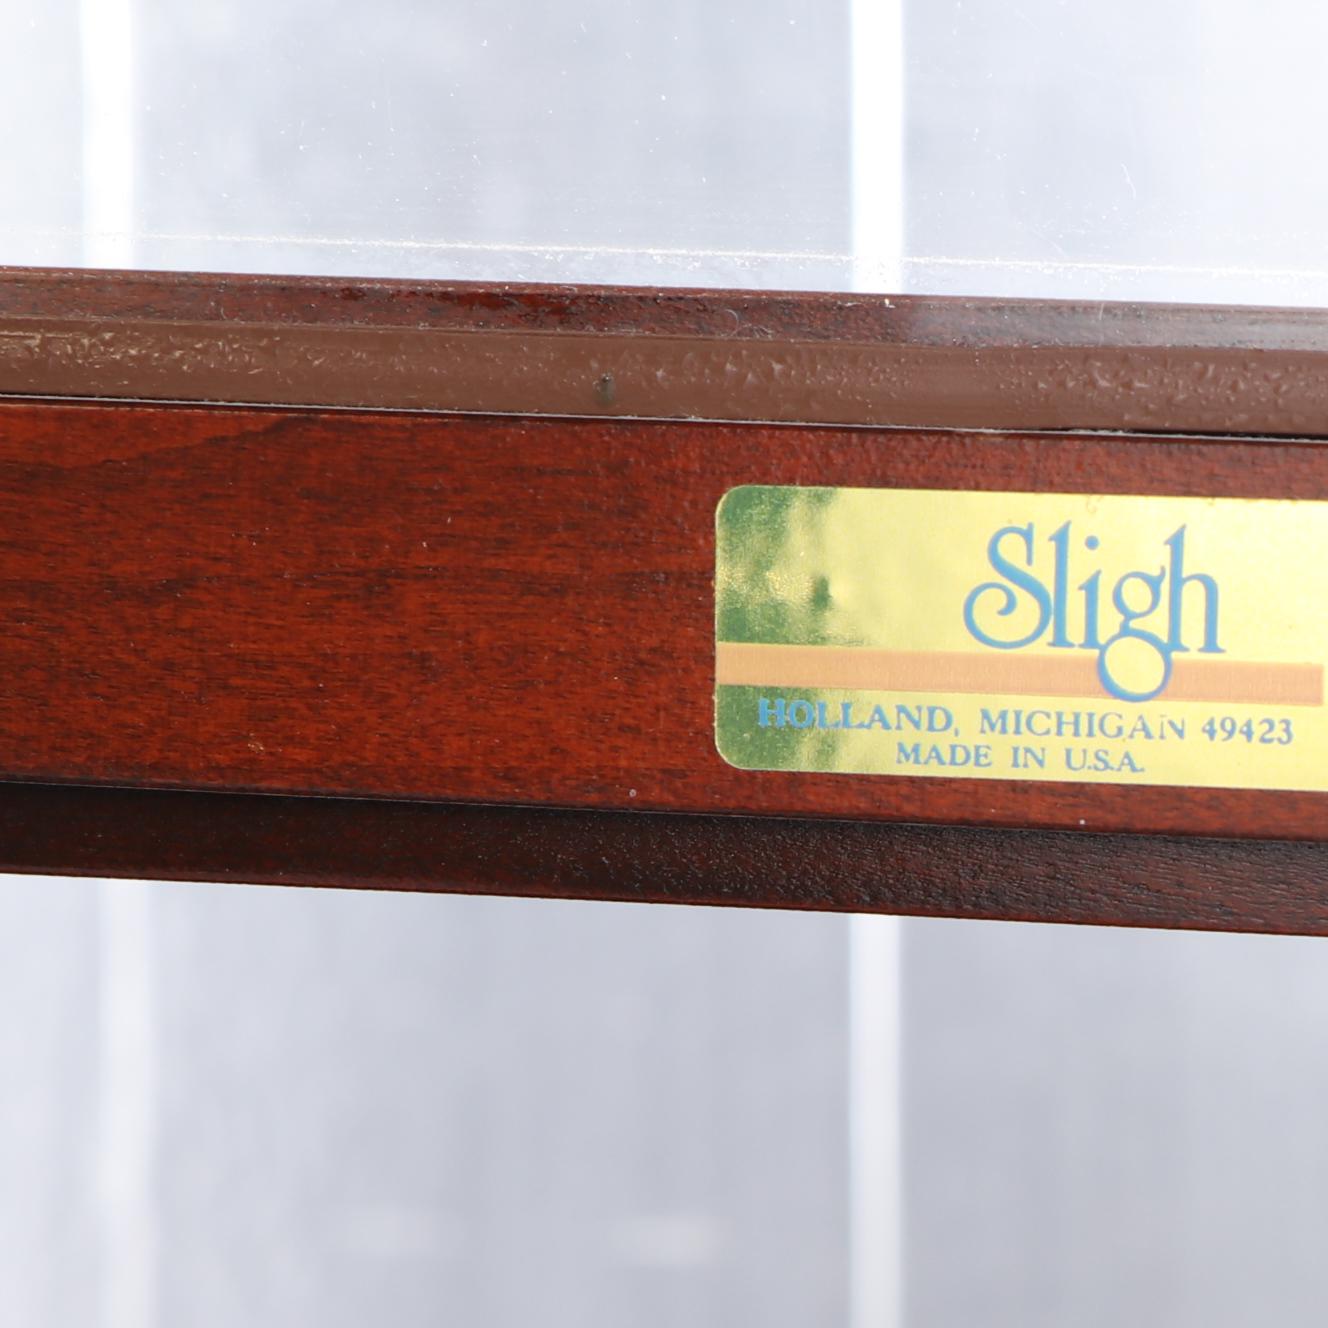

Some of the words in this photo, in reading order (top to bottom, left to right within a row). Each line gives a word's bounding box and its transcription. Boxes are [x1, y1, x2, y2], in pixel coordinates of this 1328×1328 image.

[964, 520, 1226, 702] Sligh
[757, 699, 959, 737] HOLLAND,
[979, 708, 1186, 741] MICHIGAN
[1201, 716, 1294, 745] 49423
[896, 743, 992, 768] MADE
[1011, 747, 1046, 769] IN
